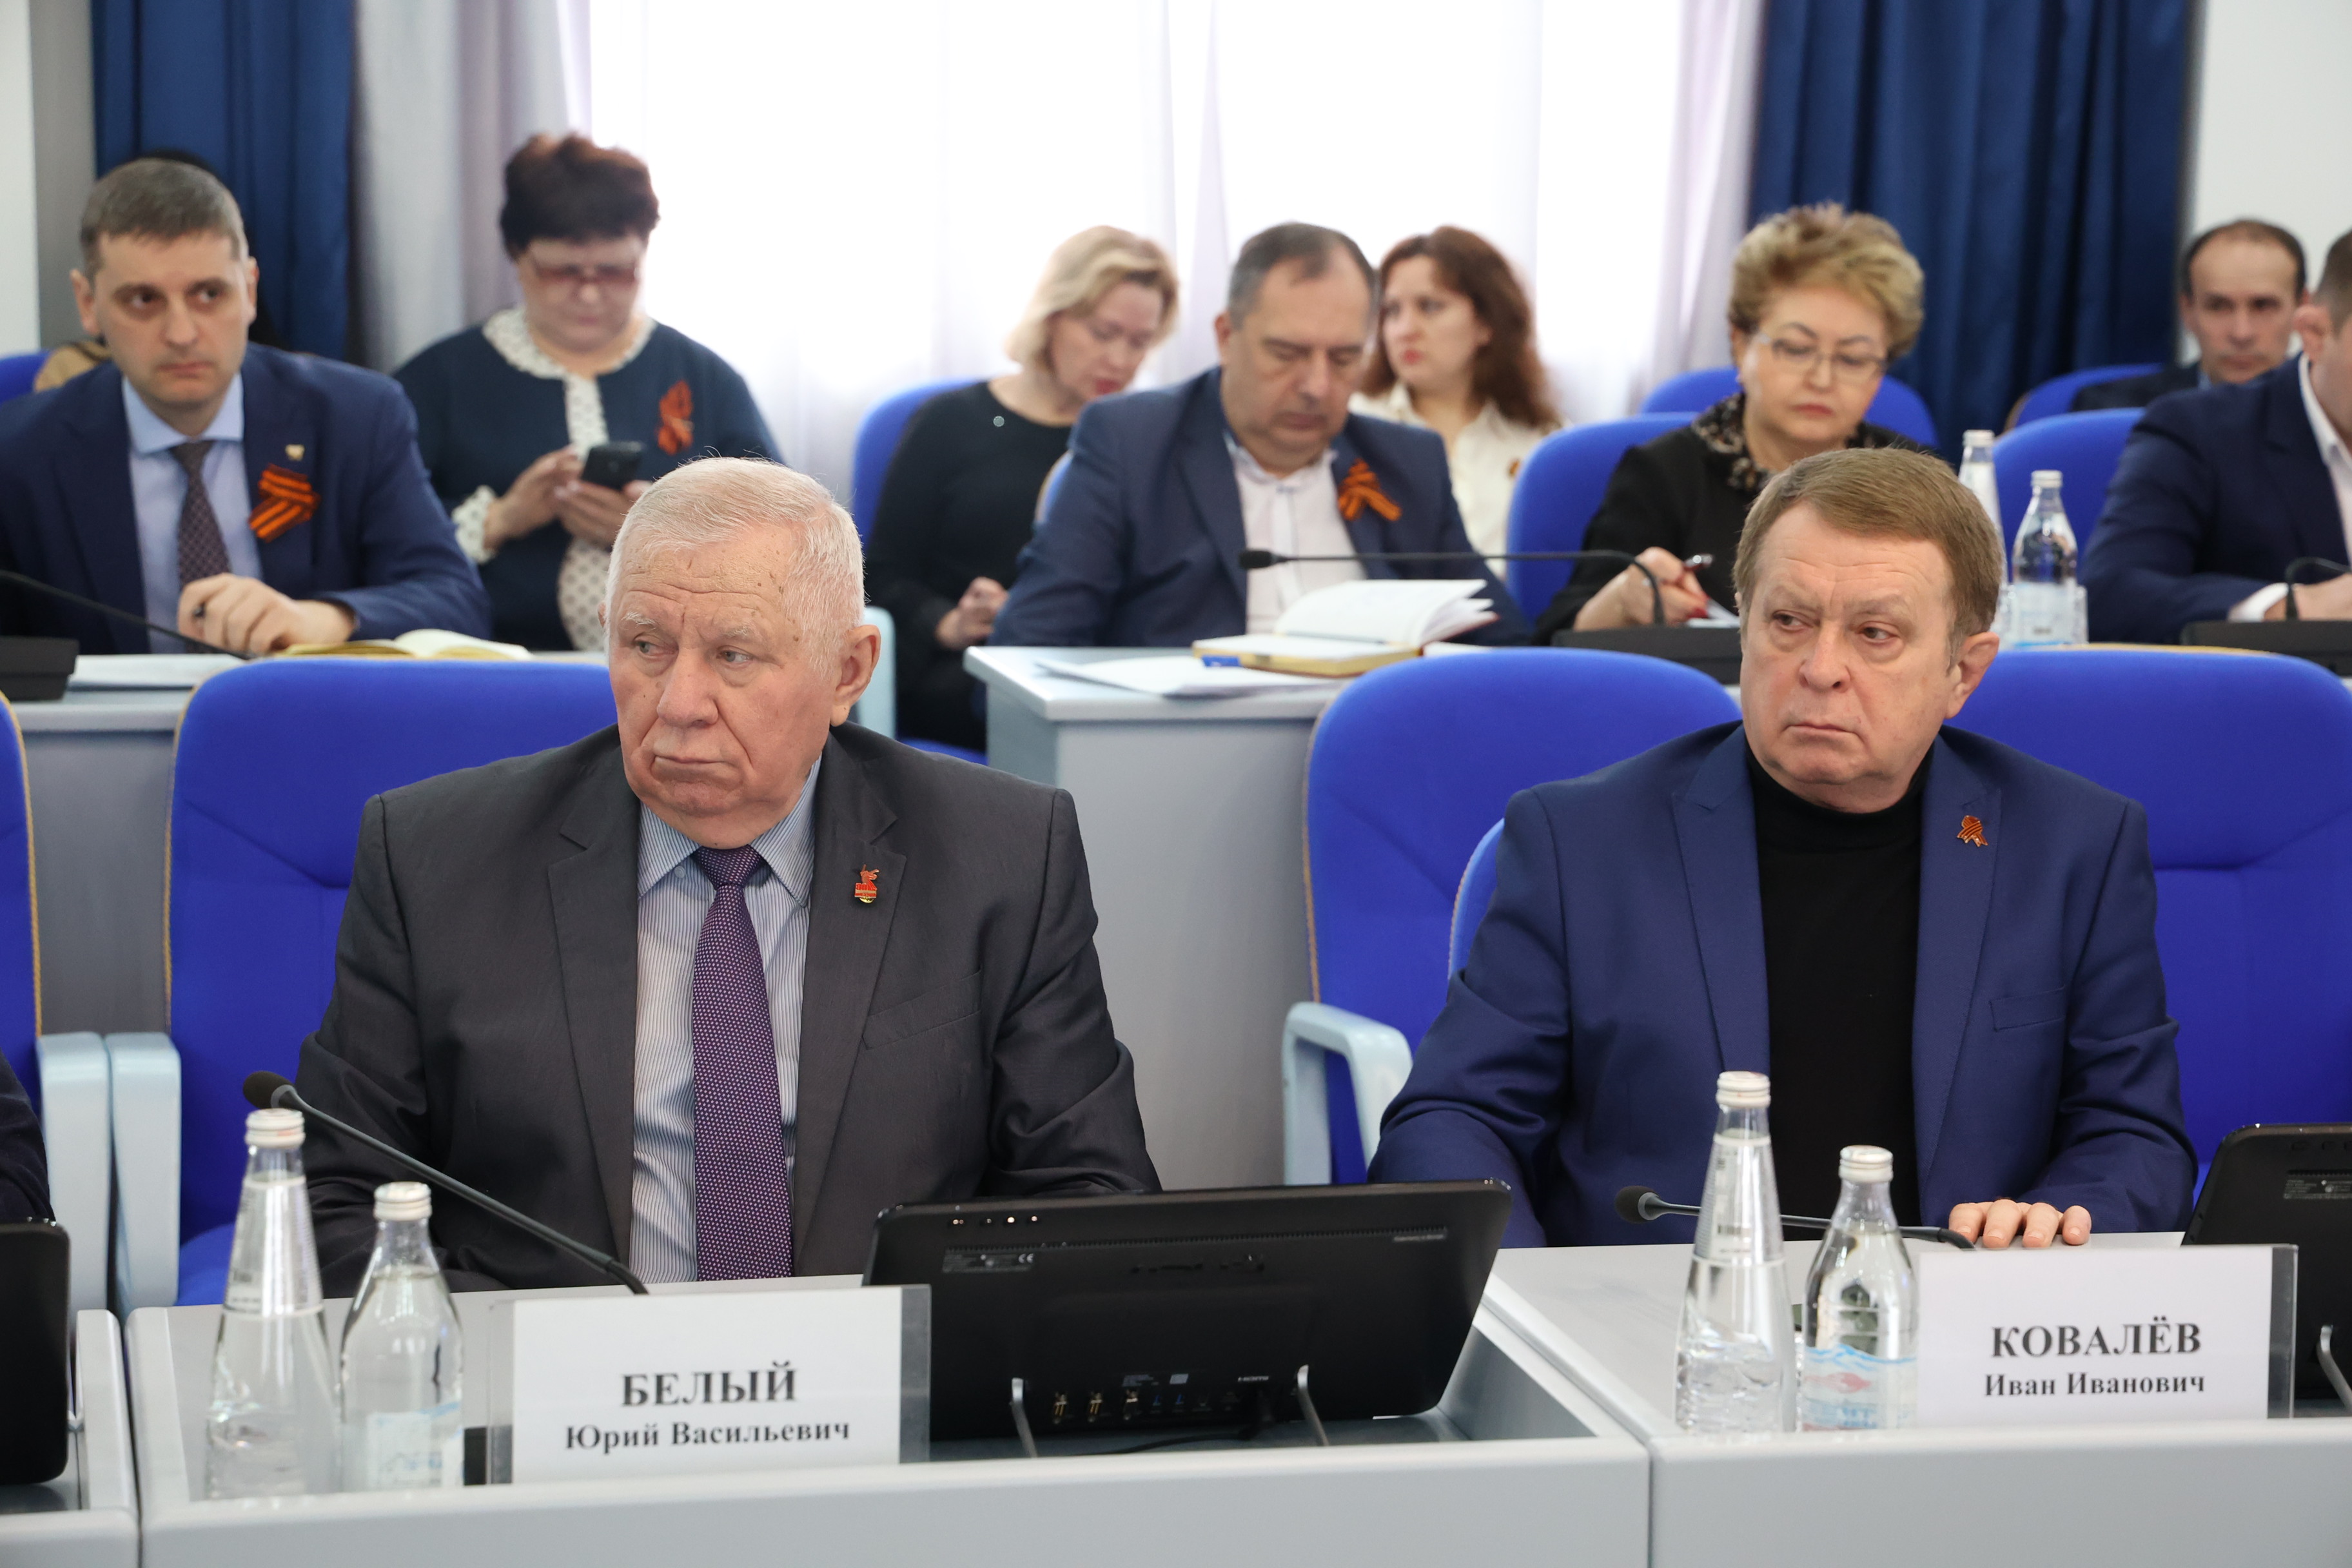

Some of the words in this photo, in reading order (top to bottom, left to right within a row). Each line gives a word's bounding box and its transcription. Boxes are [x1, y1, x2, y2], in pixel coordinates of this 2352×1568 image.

[1992, 1315, 2202, 1358] КОВАЛЁВ
[621, 1360, 797, 1407] БЕЛЫЙ
[1985, 1374, 2056, 1396] Иван
[2066, 1371, 2205, 1395] Иванович
[565, 1423, 659, 1455] Юрий
[671, 1422, 850, 1446] Васильевич
